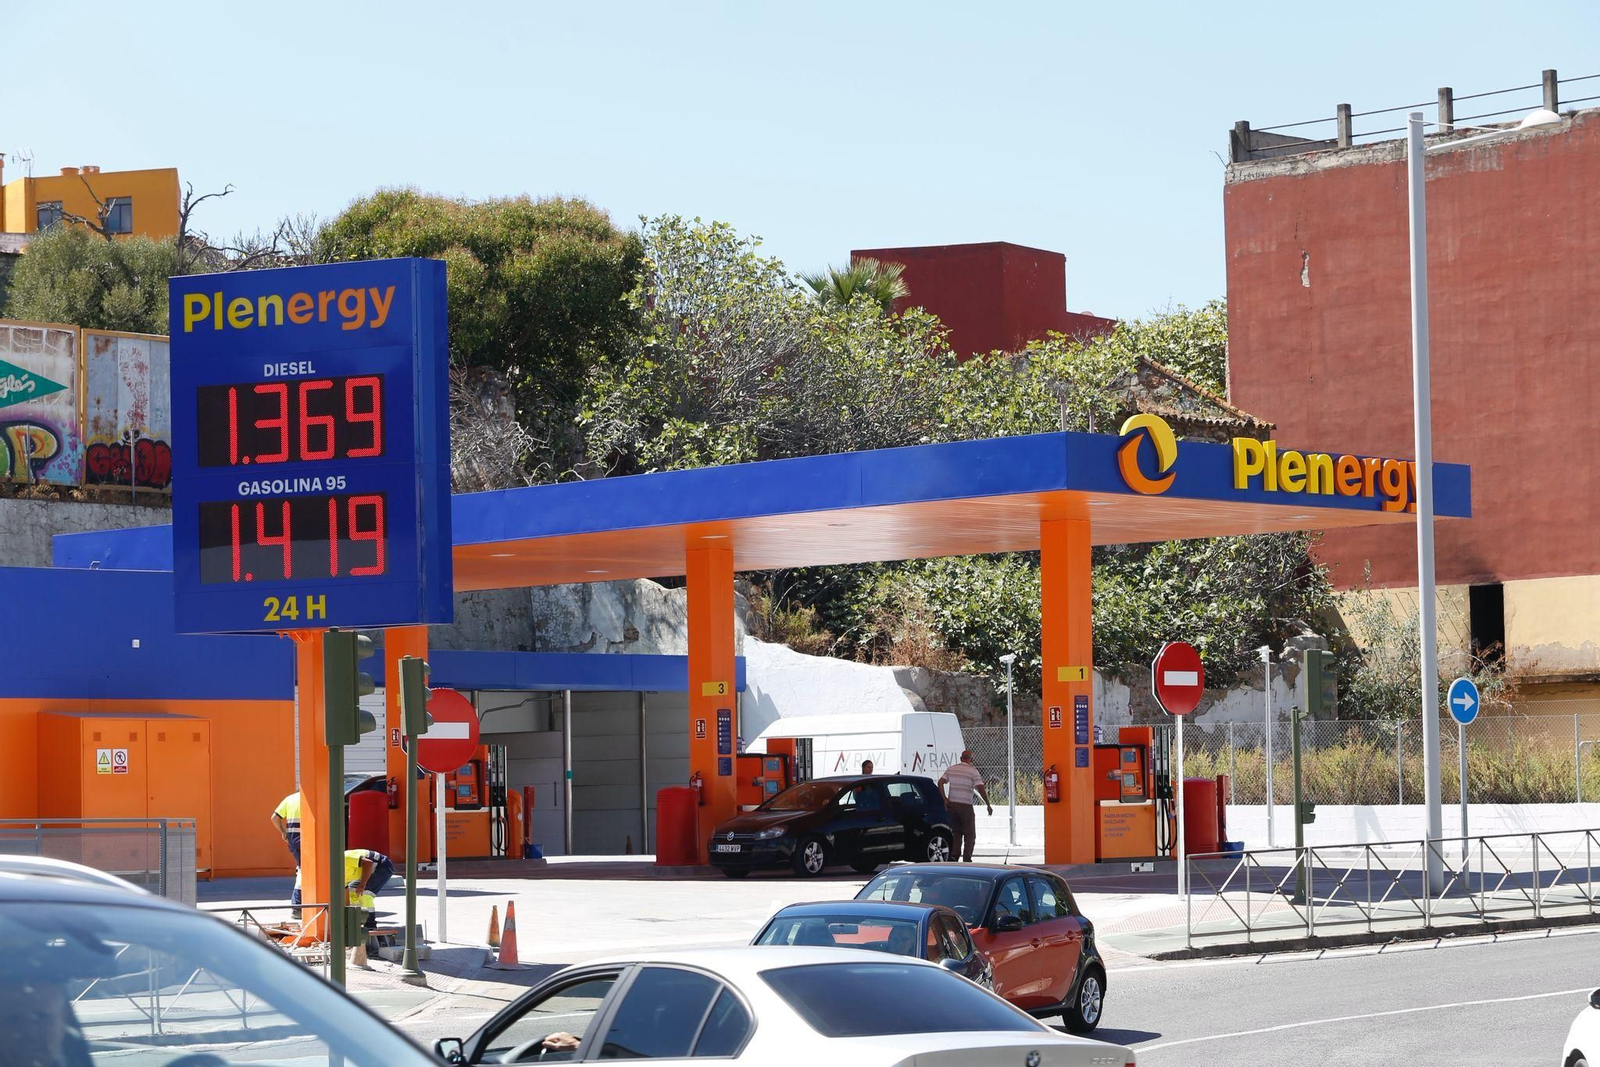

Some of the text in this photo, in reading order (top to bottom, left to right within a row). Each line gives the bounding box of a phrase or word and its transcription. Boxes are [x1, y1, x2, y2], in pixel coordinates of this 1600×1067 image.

[183, 285, 396, 333] Plenergy
[263, 361, 316, 377] DIESEL
[228, 376, 382, 466] 1.369
[238, 476, 347, 496] GASOLINA 95
[230, 495, 385, 582] 1.419
[263, 594, 326, 622] 24 H
[1078, 667, 1084, 680] 1
[718, 683, 725, 694] 3
